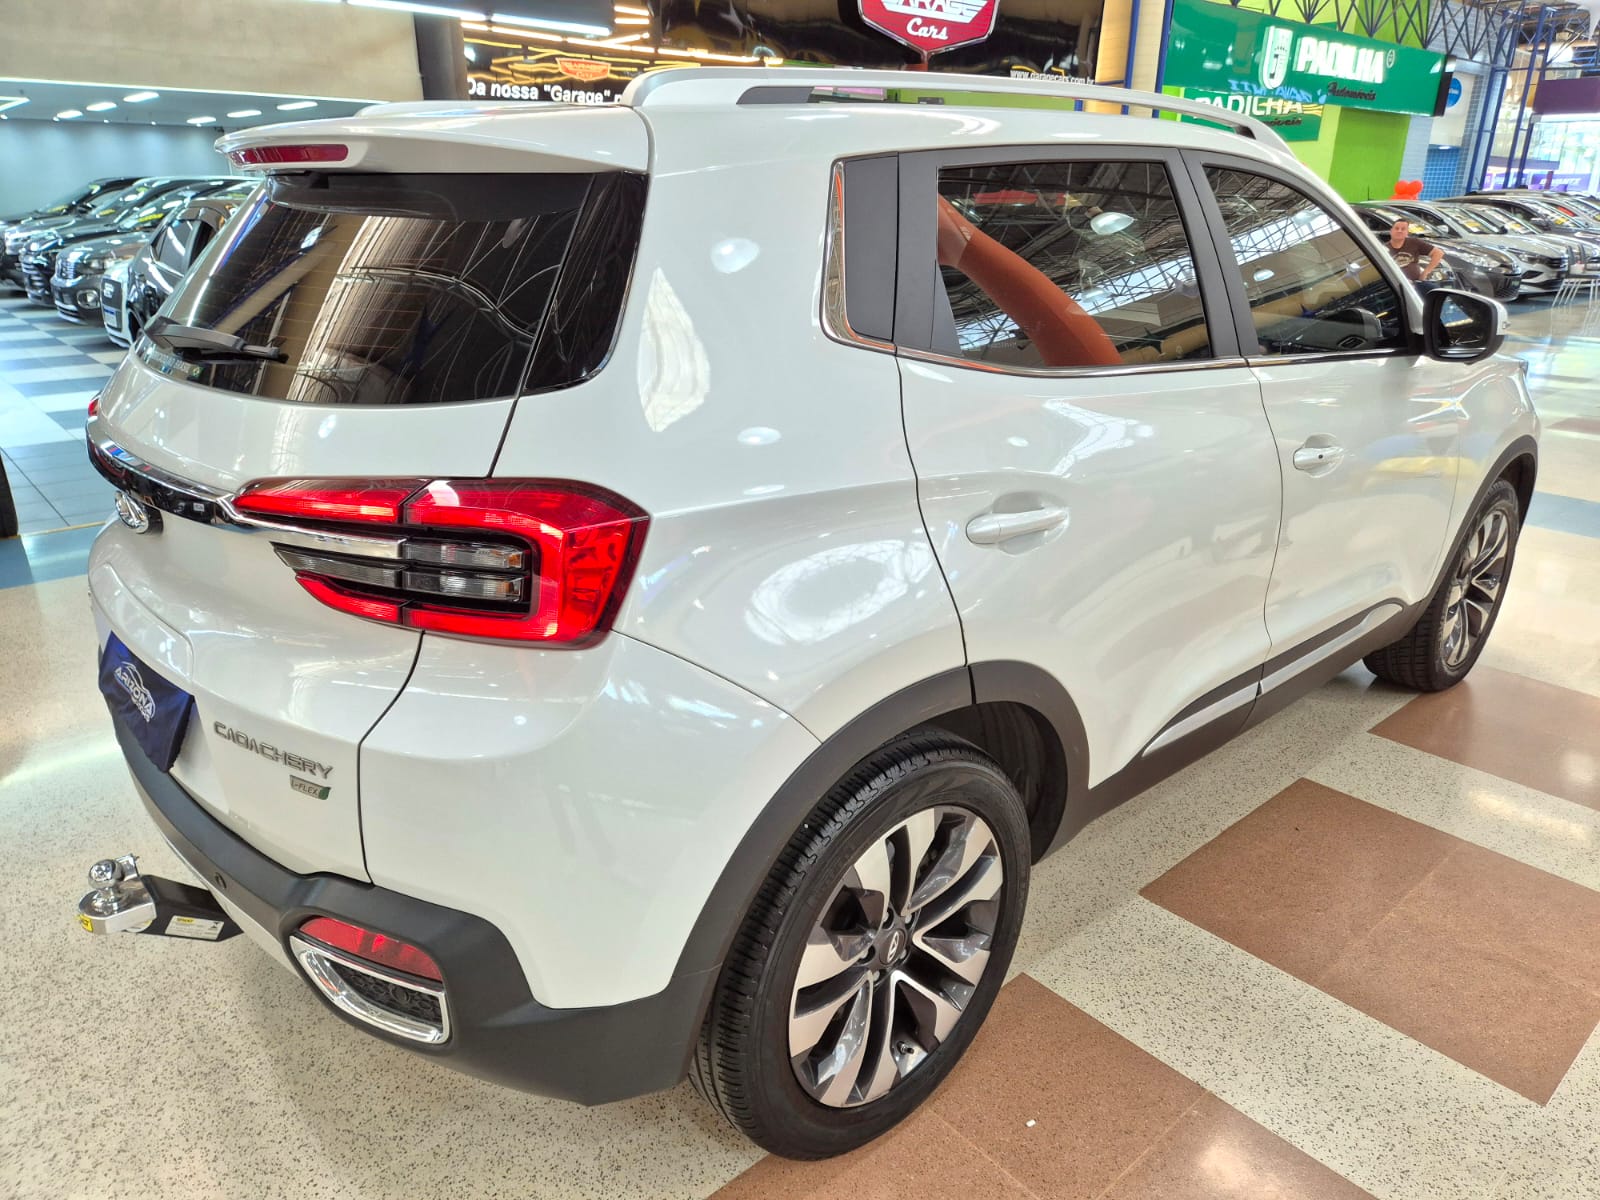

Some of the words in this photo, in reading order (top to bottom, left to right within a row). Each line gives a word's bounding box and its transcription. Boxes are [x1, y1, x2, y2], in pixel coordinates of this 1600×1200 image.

[906, 17, 949, 41] Cars
[1293, 36, 1384, 84] PADILHA
[490, 82, 539, 100] nossa
[543, 84, 611, 104] "Garage"
[114, 667, 152, 716] ARIZONA
